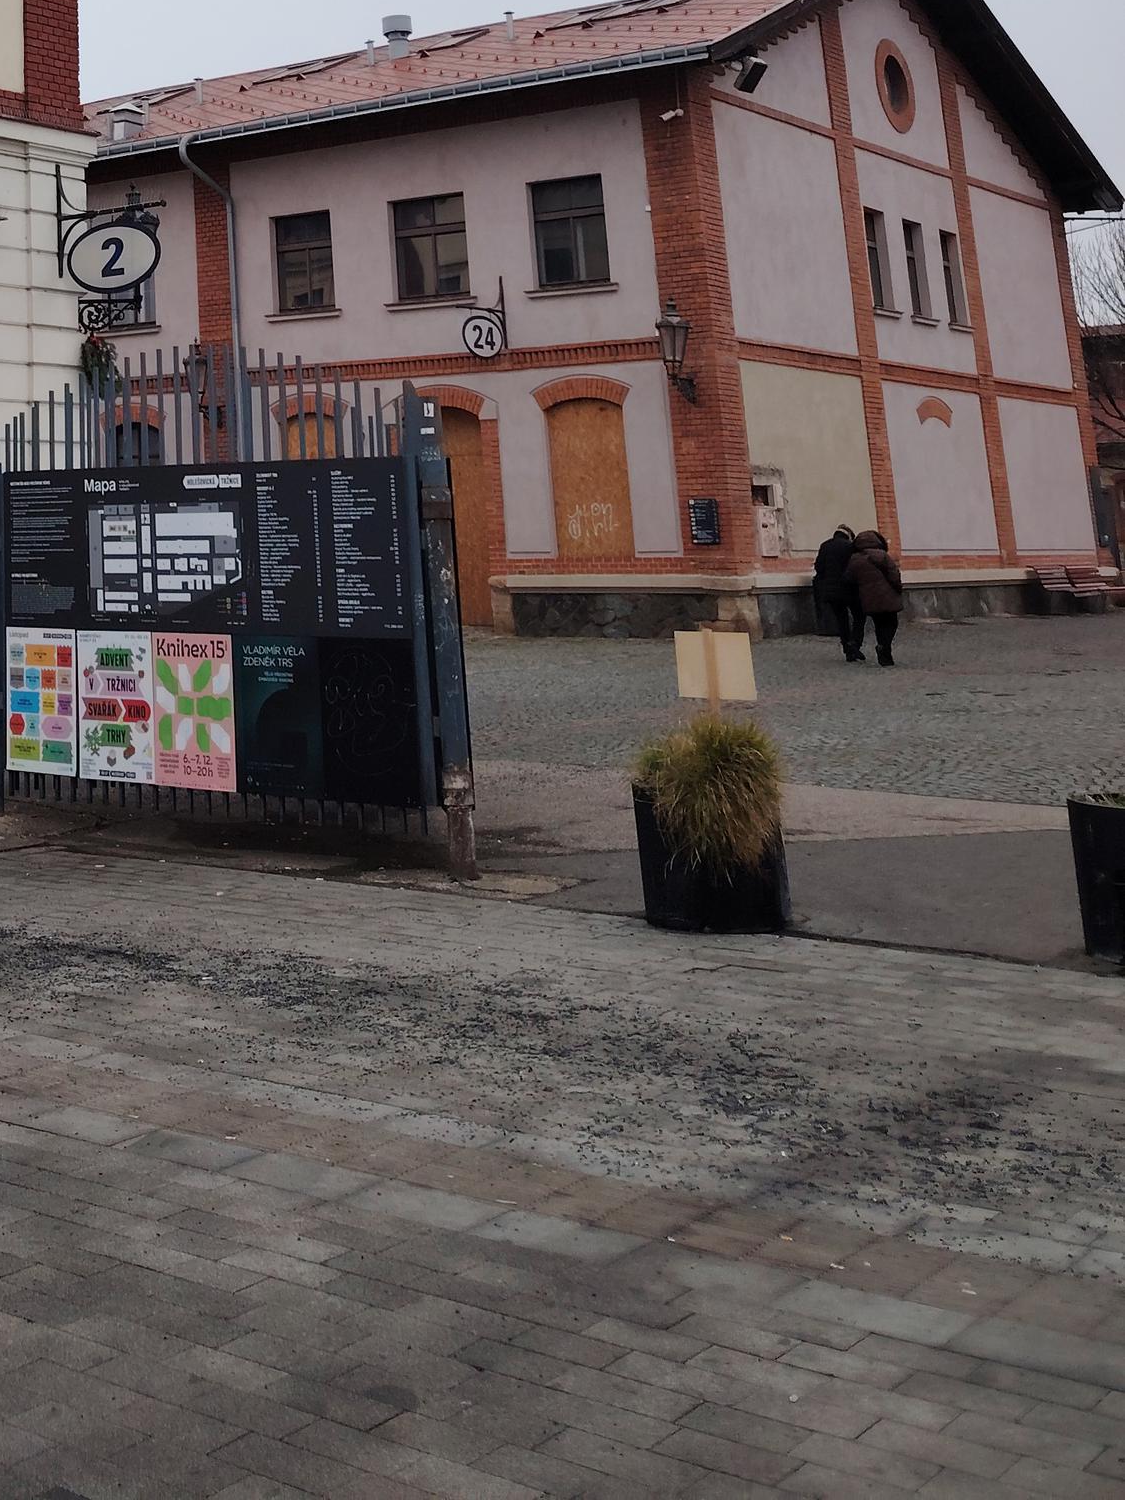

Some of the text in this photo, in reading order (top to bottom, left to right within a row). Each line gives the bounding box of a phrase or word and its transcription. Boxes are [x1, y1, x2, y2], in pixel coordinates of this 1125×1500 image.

[101, 237, 125, 278] 2
[472, 324, 496, 350] 24
[84, 479, 117, 495] Mapa
[156, 638, 225, 658] Knihex 15
[242, 644, 282, 656] VLADIMÍR
[100, 653, 129, 667] ADVENT
[243, 656, 294, 668] ZDENĚK TRS
[88, 675, 136, 692] V TRŽNICI
[127, 705, 147, 719] KINO
[106, 729, 126, 744] TRHY
